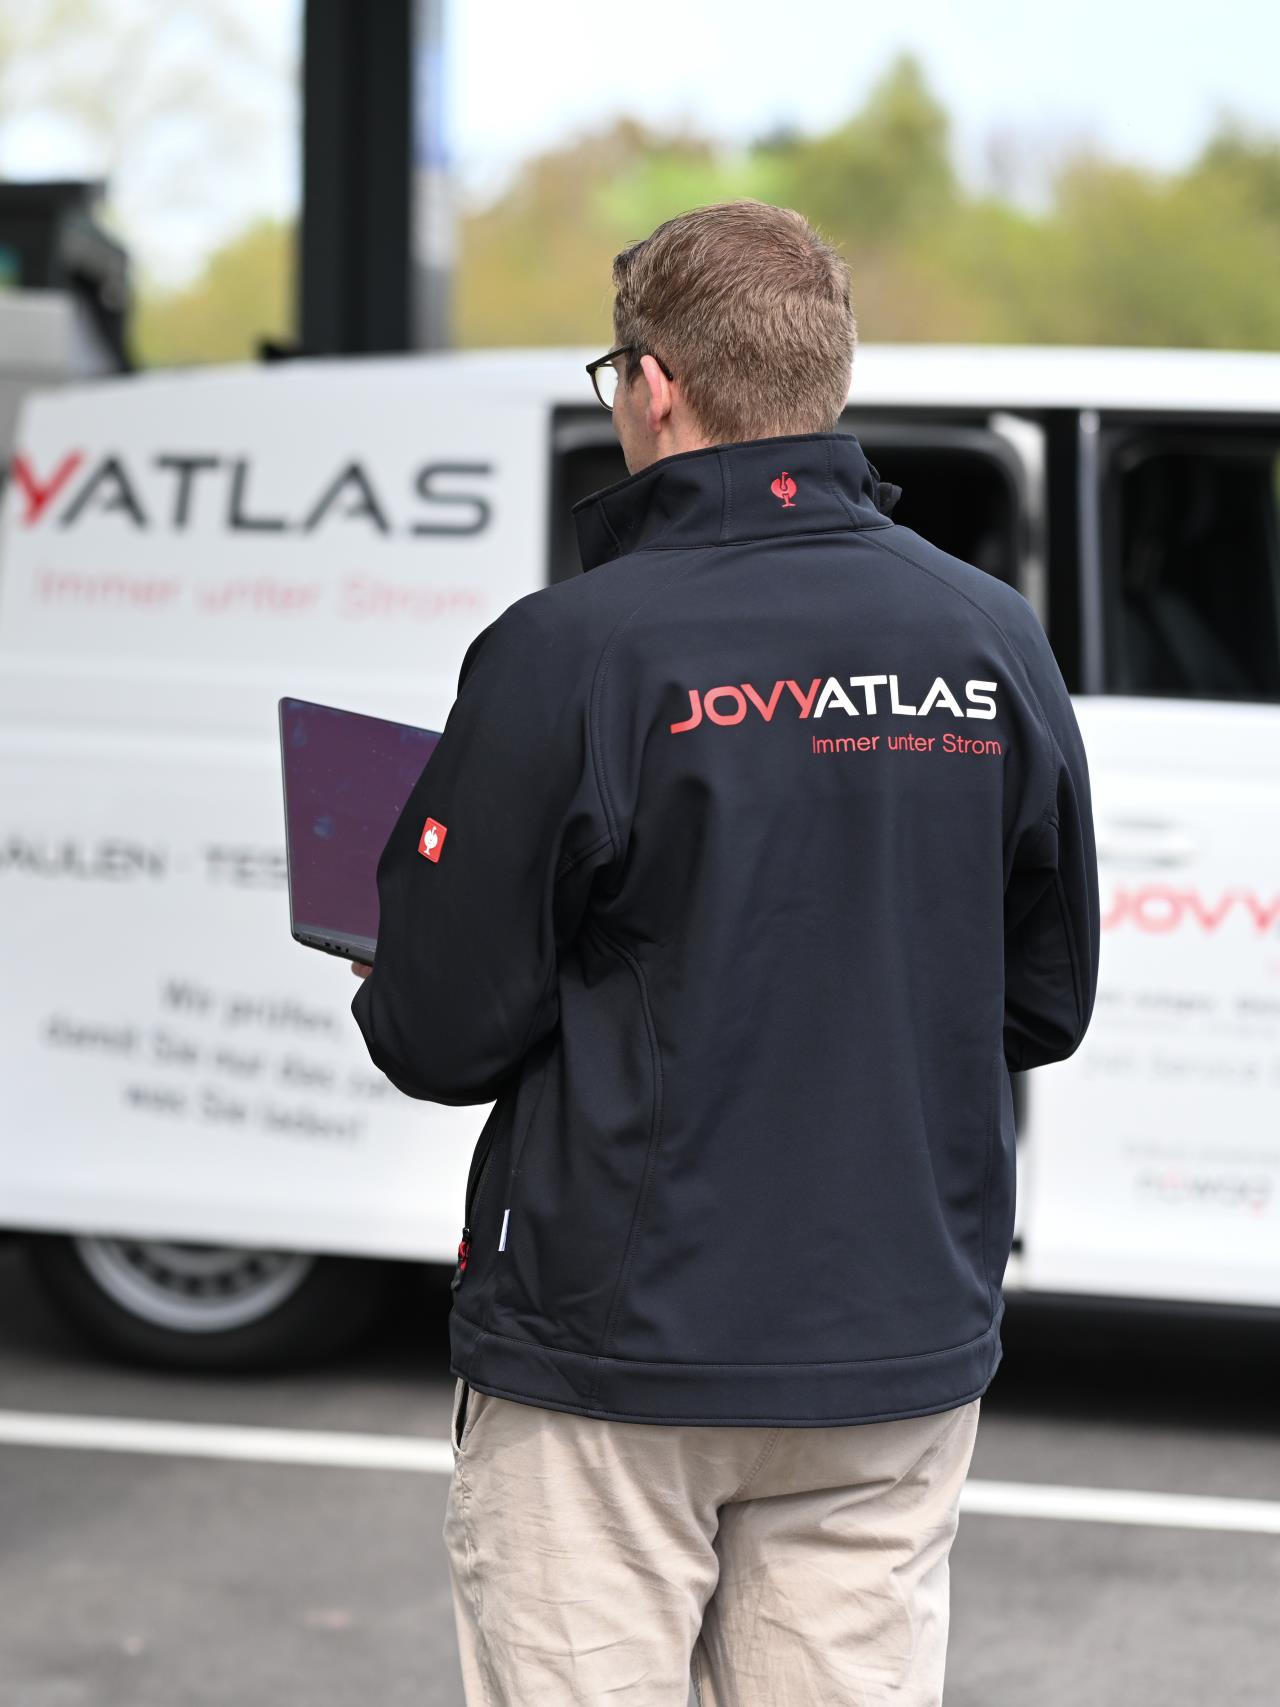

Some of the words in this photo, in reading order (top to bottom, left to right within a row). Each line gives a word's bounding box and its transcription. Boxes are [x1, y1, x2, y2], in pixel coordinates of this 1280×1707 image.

[670, 675, 998, 734] JOVYATLAS
[812, 734, 880, 754] Immer
[888, 734, 937, 753] unter
[942, 733, 1002, 755] Strom
